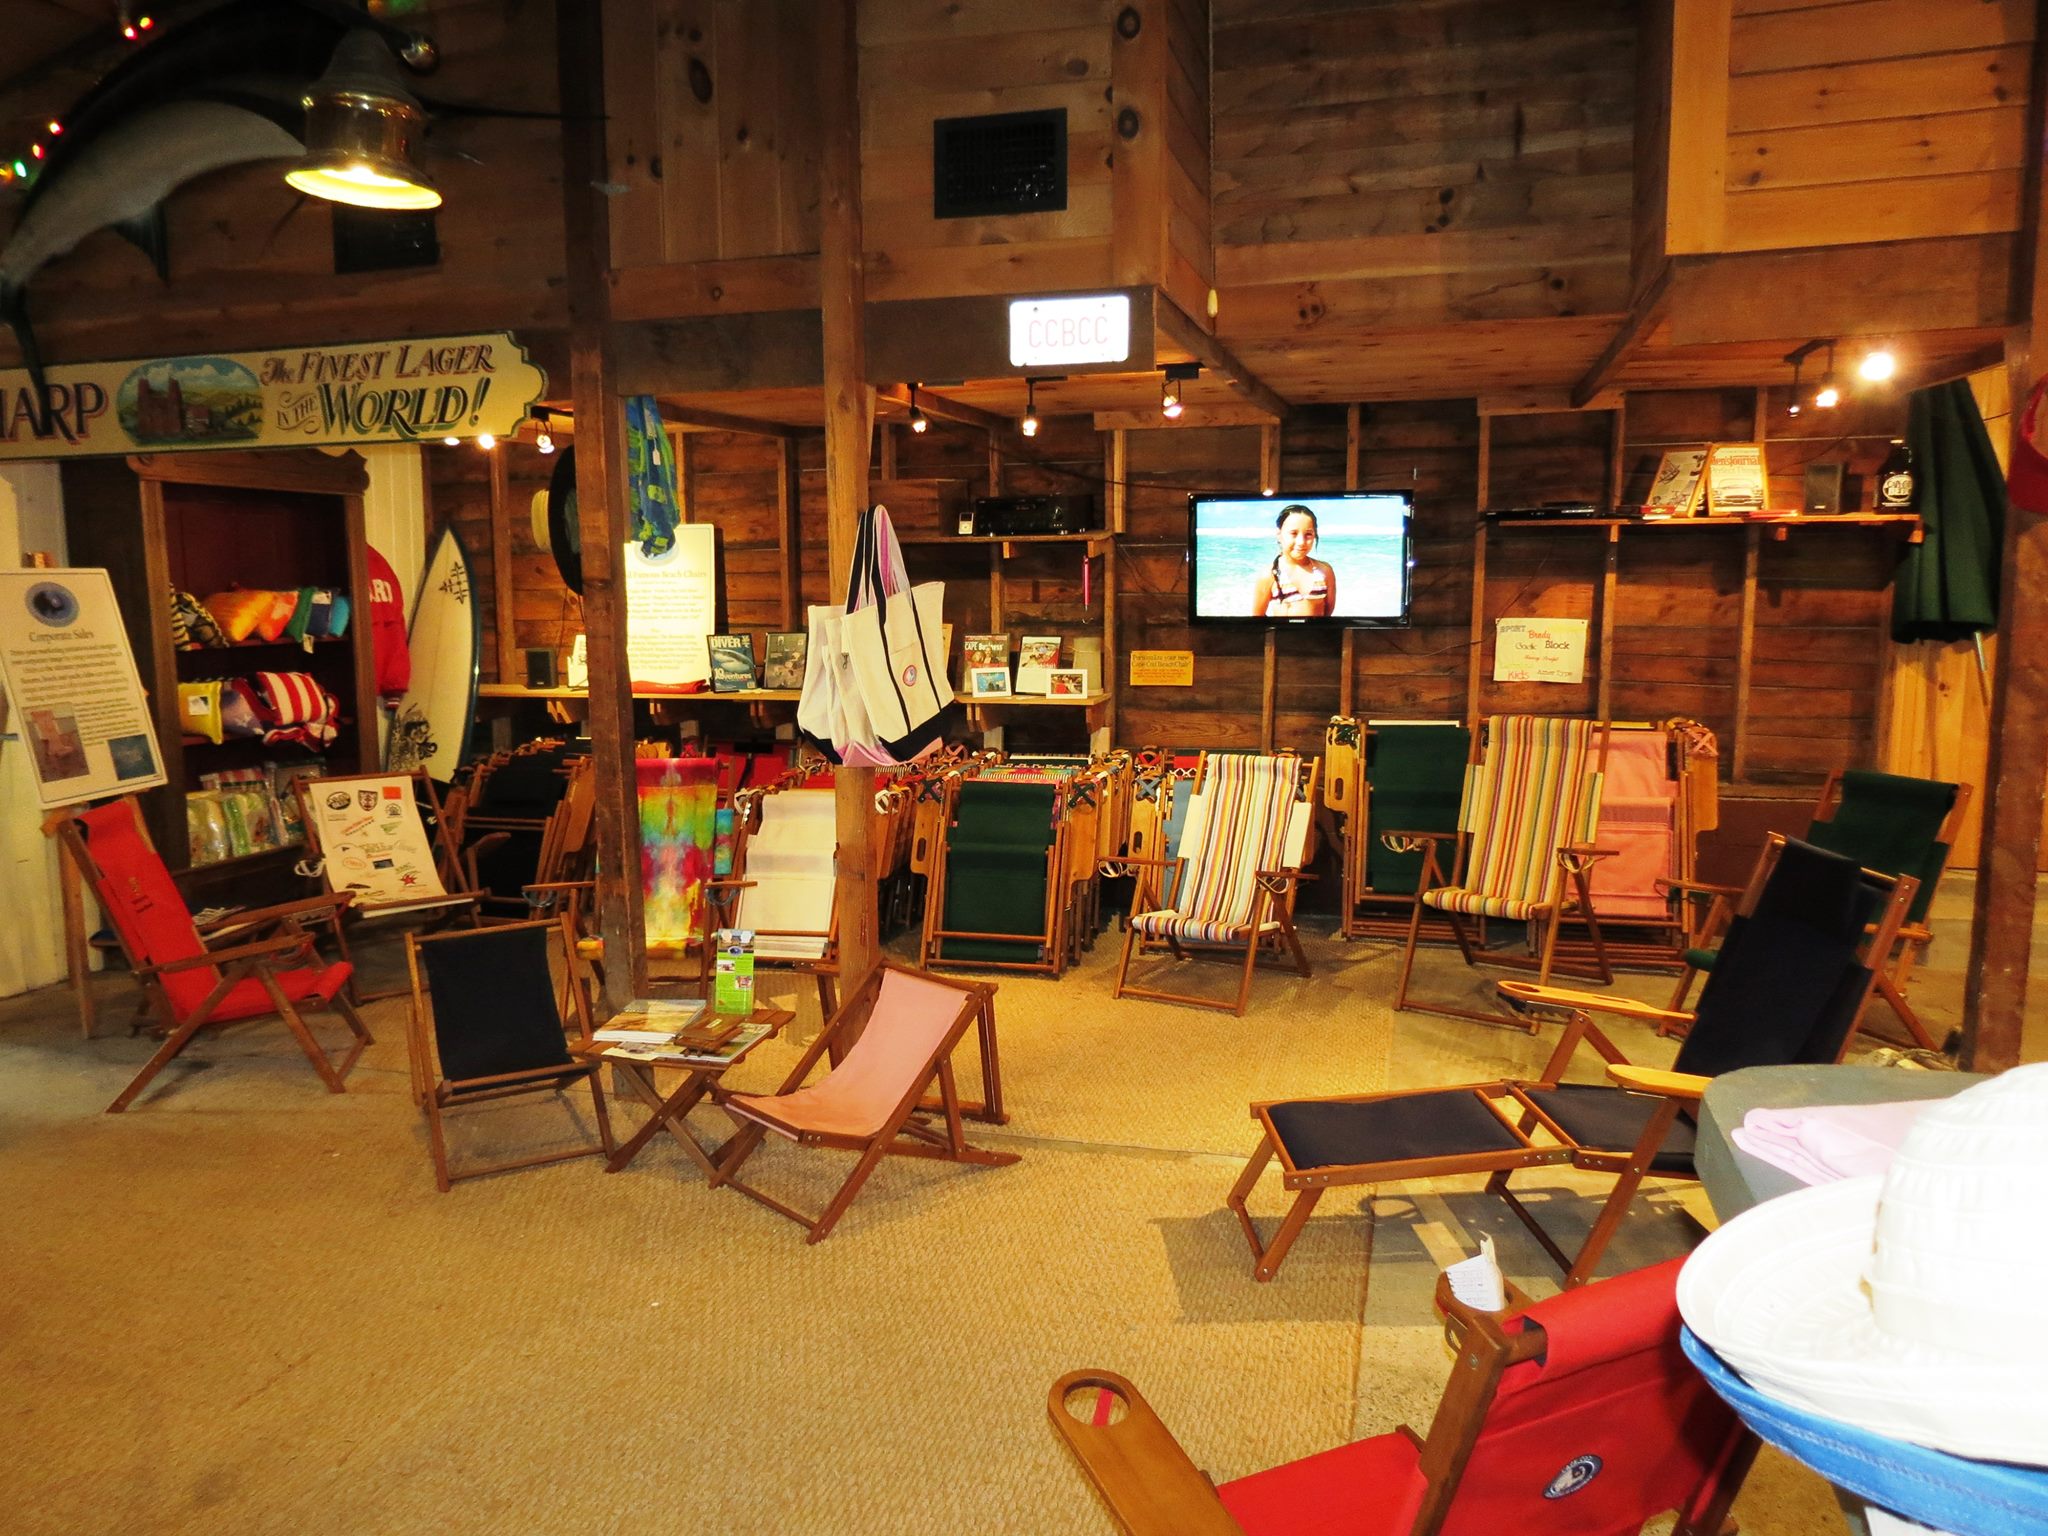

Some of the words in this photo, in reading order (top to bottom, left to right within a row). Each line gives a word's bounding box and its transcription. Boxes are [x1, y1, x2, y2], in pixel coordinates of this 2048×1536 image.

[1028, 315, 1109, 349] CCBCC
[260, 357, 296, 386] The
[298, 349, 389, 383] FINEST
[394, 343, 495, 379] LAGER
[276, 409, 290, 427] IN
[293, 395, 318, 423] THE
[317, 377, 491, 436] WORLD!
[368, 578, 394, 604] RD
[710, 637, 741, 648] DIVER
[964, 641, 978, 651] CAPE
[1545, 640, 1570, 650] Block
